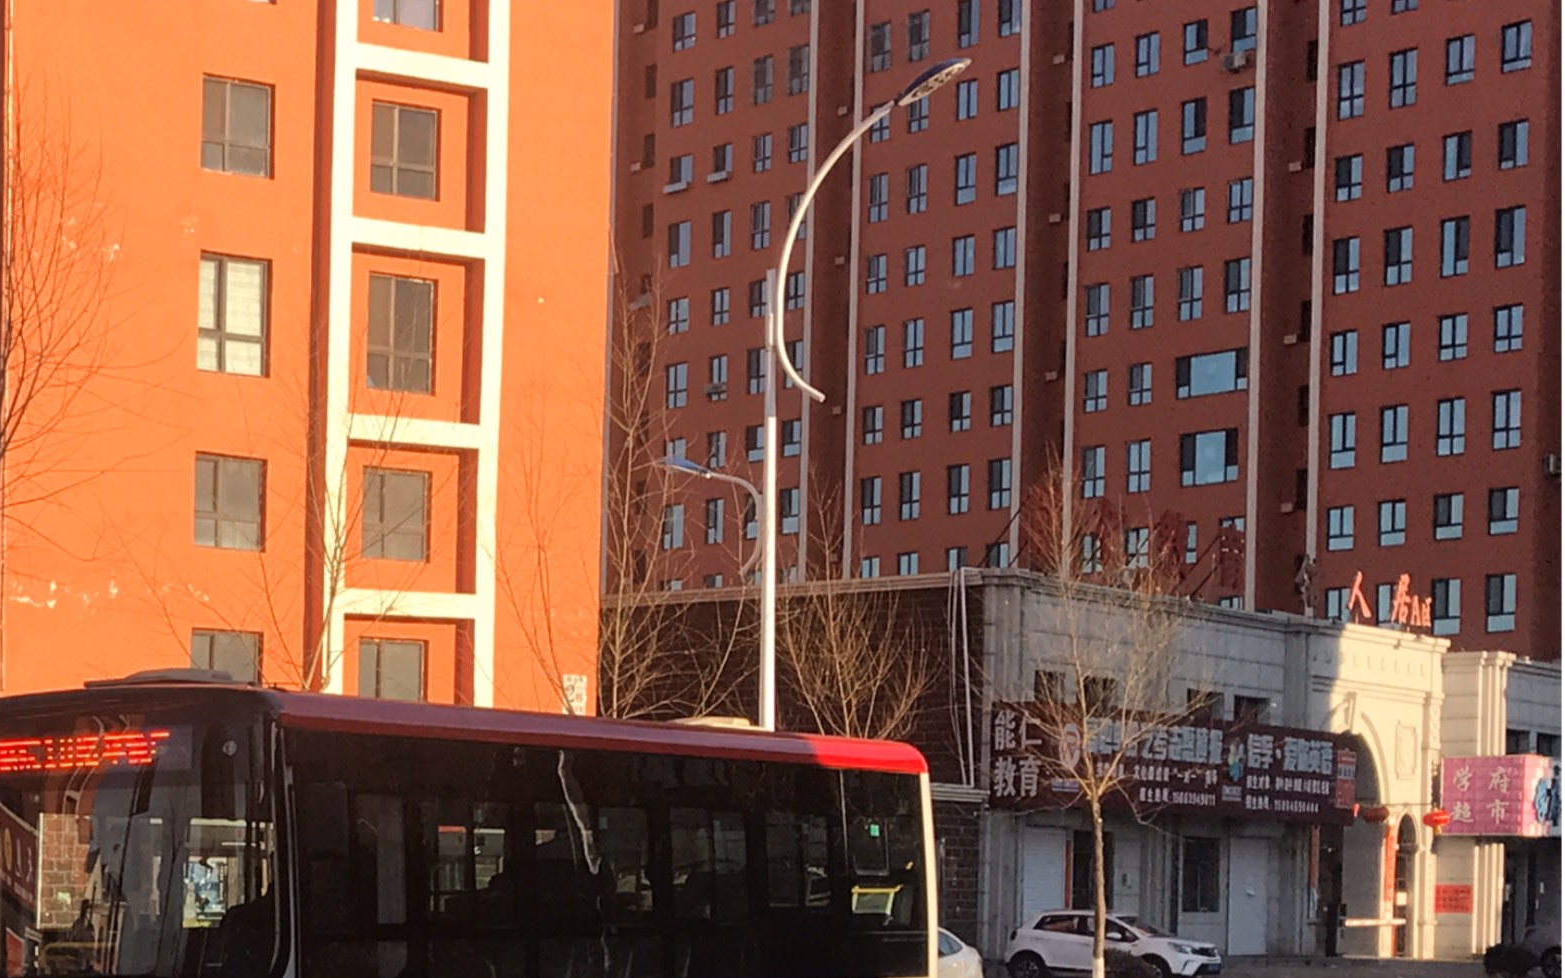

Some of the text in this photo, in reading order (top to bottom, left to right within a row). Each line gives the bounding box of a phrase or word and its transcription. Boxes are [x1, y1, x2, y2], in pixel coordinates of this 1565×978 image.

[994, 709, 1042, 750] 能仁
[993, 755, 1042, 798] 教育
[1453, 765, 1510, 793] 学府
[1450, 799, 1509, 826] 超市
